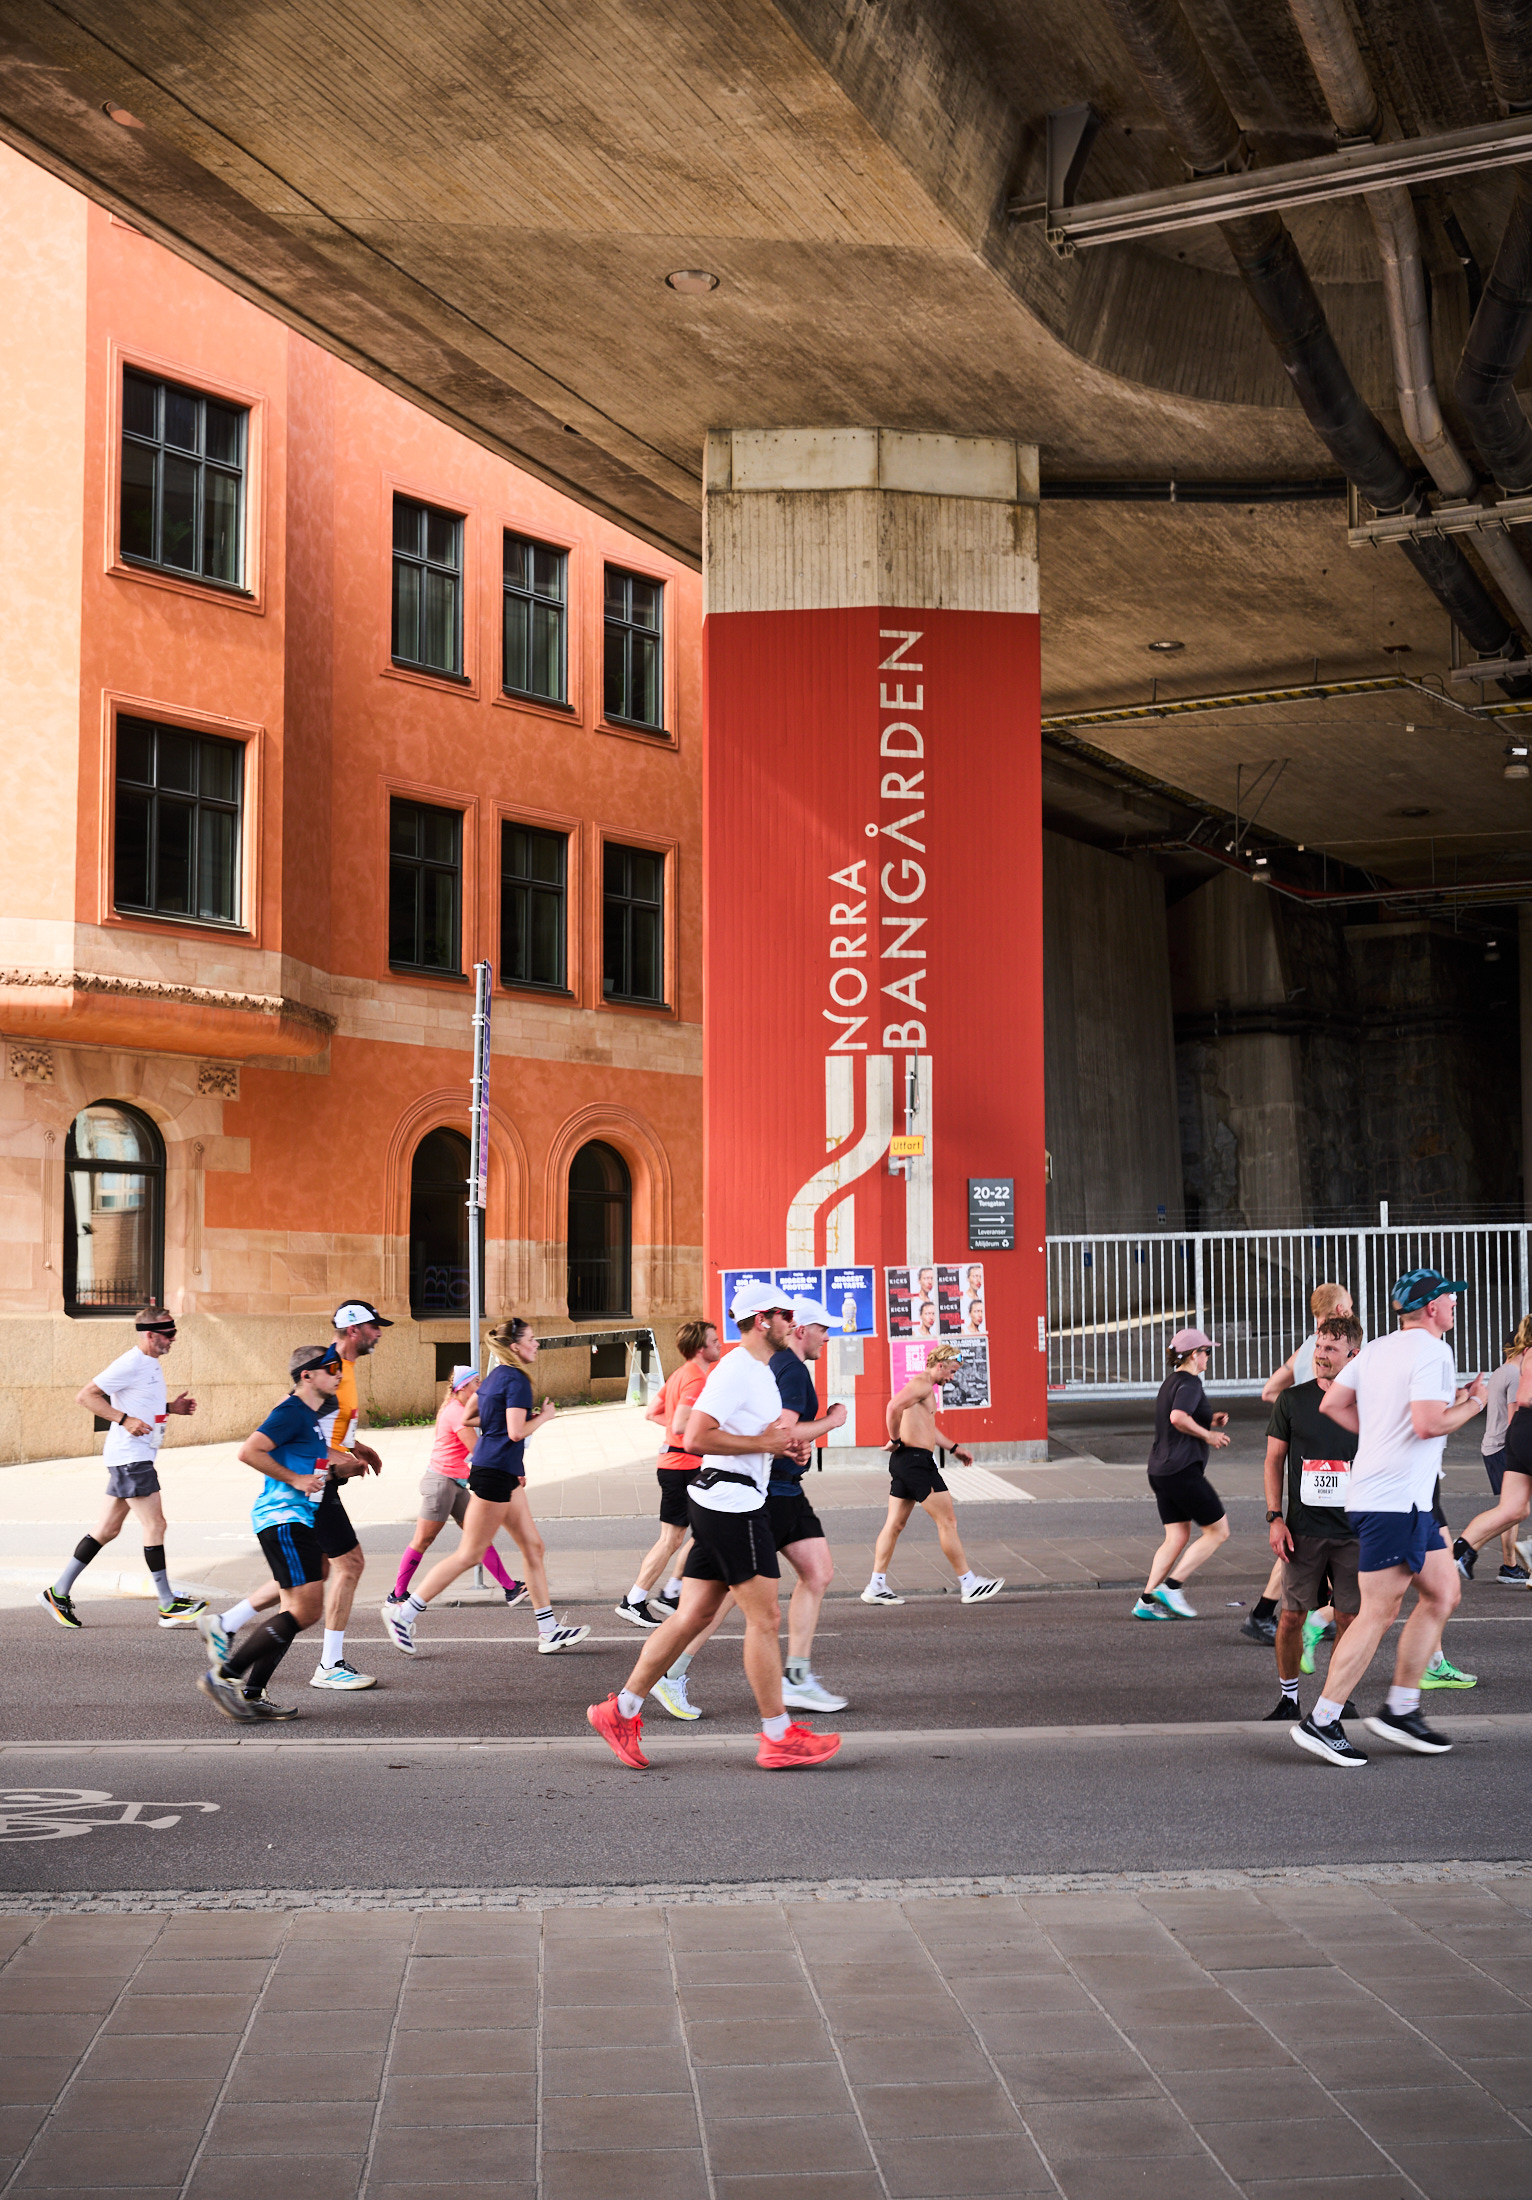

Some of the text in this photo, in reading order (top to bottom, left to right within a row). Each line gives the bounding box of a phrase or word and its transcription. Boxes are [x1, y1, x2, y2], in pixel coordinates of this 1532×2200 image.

[865, 629, 928, 1049] BANGÅRDEN
[822, 859, 869, 1051] NORRA
[893, 1141, 920, 1150] Utfart
[973, 1186, 1010, 1199] 20-22
[978, 1200, 1005, 1208] Torsgatan
[975, 1240, 999, 1248] Miljörum
[843, 1281, 867, 1289] TASTE.
[1313, 1475, 1338, 1487] 33211
